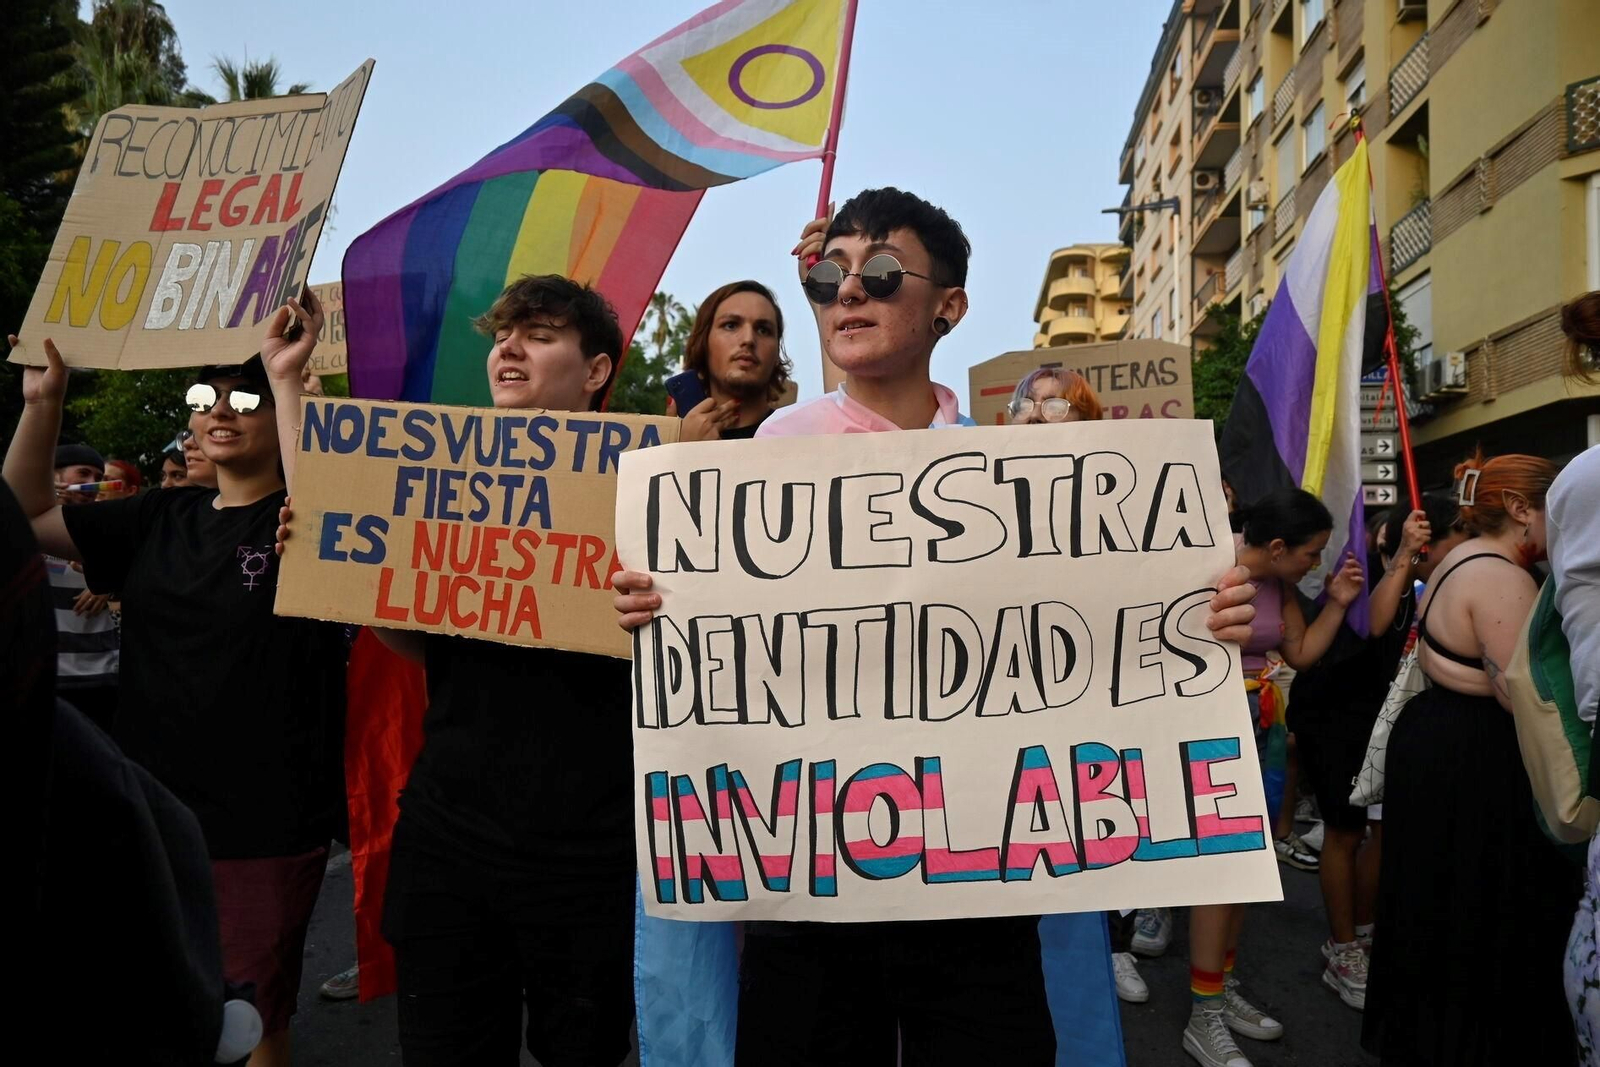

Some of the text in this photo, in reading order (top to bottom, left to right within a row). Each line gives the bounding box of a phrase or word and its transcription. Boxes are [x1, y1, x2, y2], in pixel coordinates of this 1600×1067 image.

[150, 171, 304, 232] LEGAL
[44, 235, 153, 331] NO
[318, 511, 390, 565] ES
[392, 465, 552, 530] FIESTA
[647, 451, 1216, 579] NUESTRA
[374, 567, 543, 640] LUCHA
[633, 587, 1232, 729] IDENTIDAD ES
[645, 737, 1267, 904] INVIOLABLE
